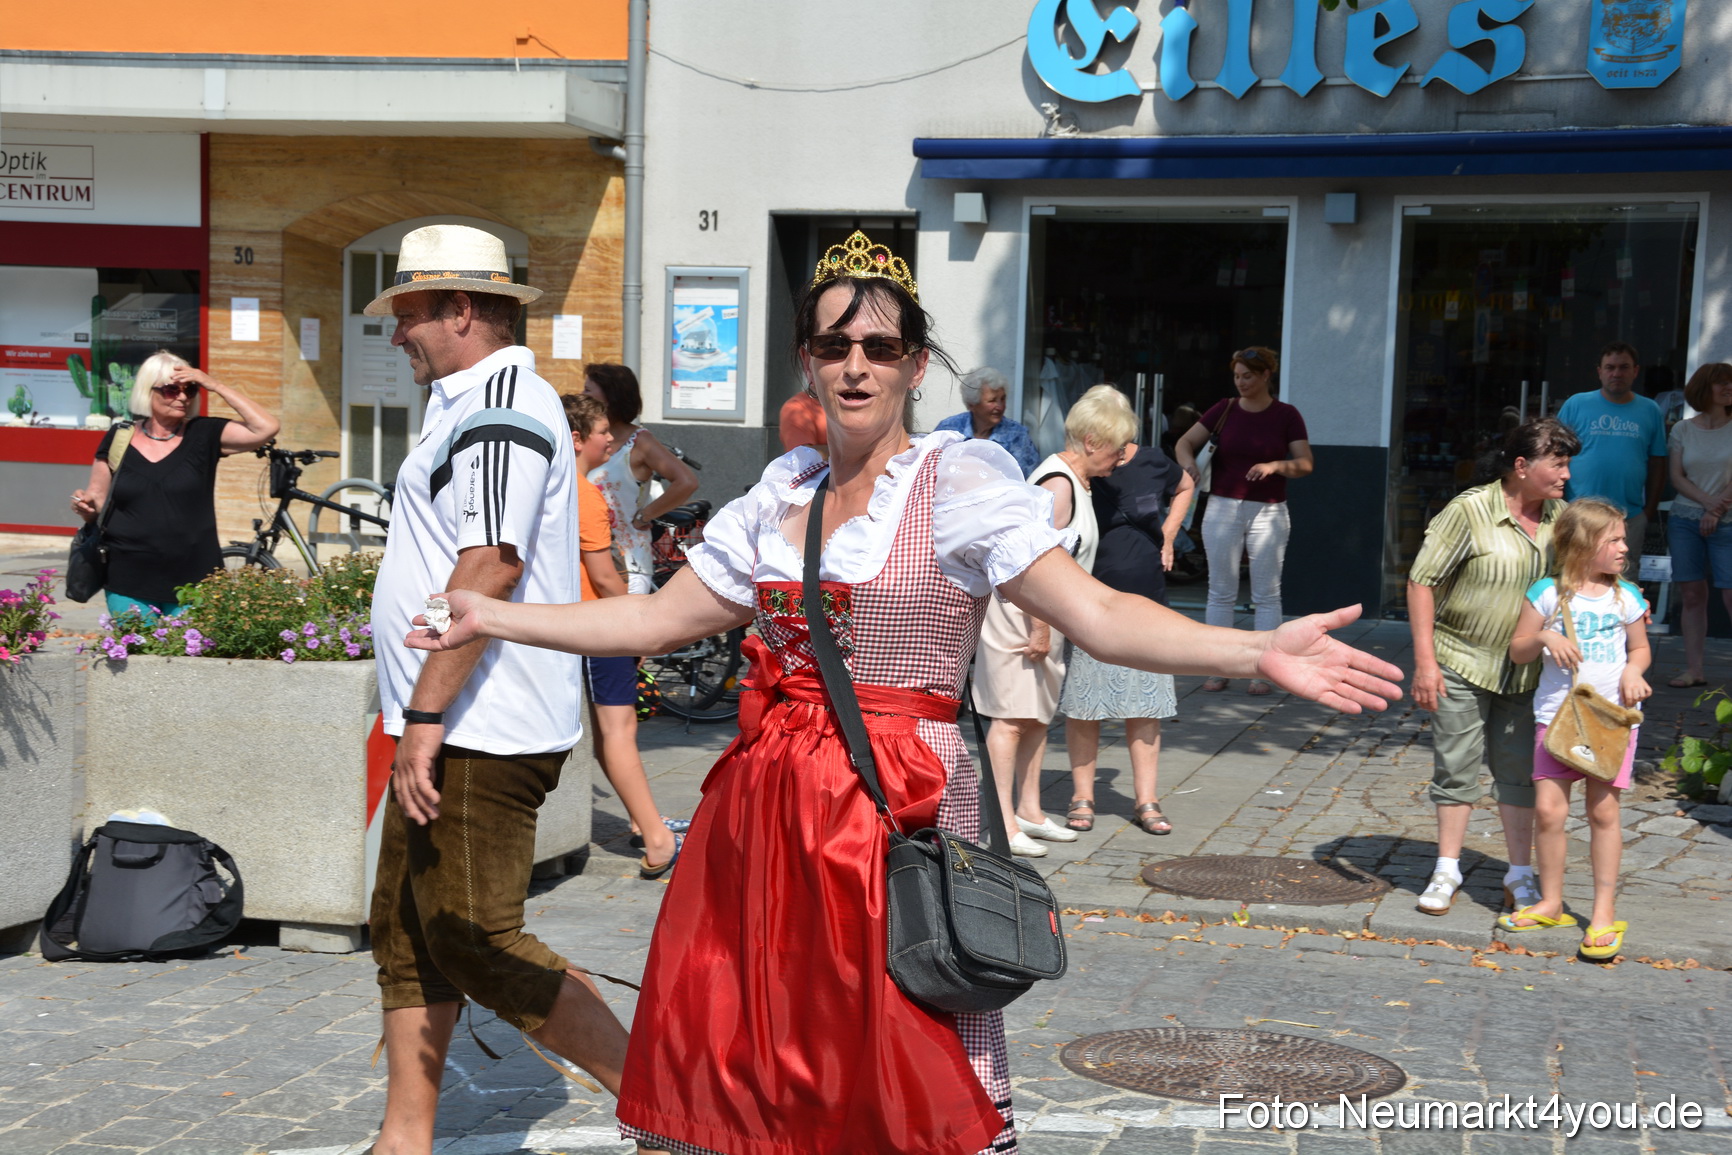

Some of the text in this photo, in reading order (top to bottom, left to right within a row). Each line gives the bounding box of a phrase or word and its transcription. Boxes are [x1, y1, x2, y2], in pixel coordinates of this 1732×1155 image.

[1027, 0, 1534, 102] Eilles
[1606, 68, 1629, 78] seit
[0, 150, 47, 174] Optik
[699, 209, 718, 231] 31
[234, 246, 254, 265] 30
[1590, 414, 1639, 432] s.Oliver
